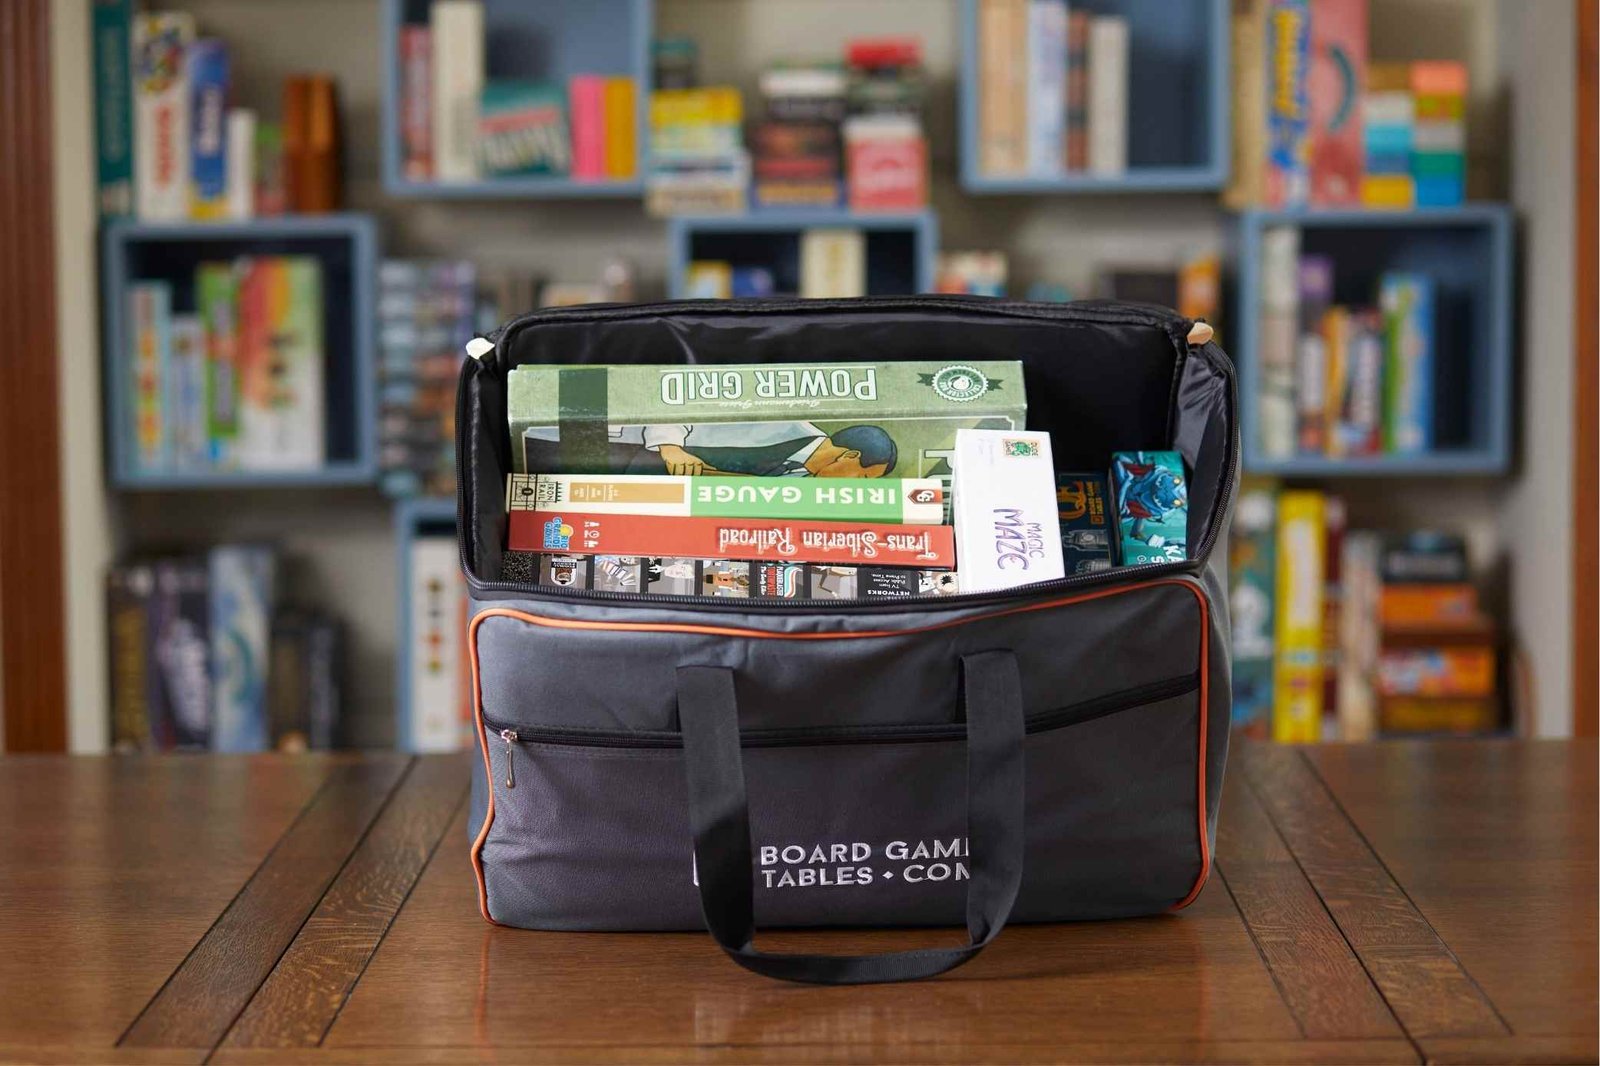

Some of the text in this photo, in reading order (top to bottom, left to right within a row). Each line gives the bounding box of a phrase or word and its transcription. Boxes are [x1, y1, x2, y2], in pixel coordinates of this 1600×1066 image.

[660, 368, 878, 405] POWER GRID
[538, 484, 546, 500] RAIL
[546, 483, 554, 501] IRON
[697, 485, 896, 505] IRISH GAUGE
[544, 522, 553, 548] GAMES
[553, 518, 561, 548] GRANDE
[561, 535, 569, 548] RIO
[719, 527, 939, 560] Trans-Siberian Railroad
[993, 509, 1029, 570] MAZE
[1027, 522, 1044, 558] MAGIC
[760, 841, 871, 866] BOARD
[761, 866, 873, 888] TABLES
